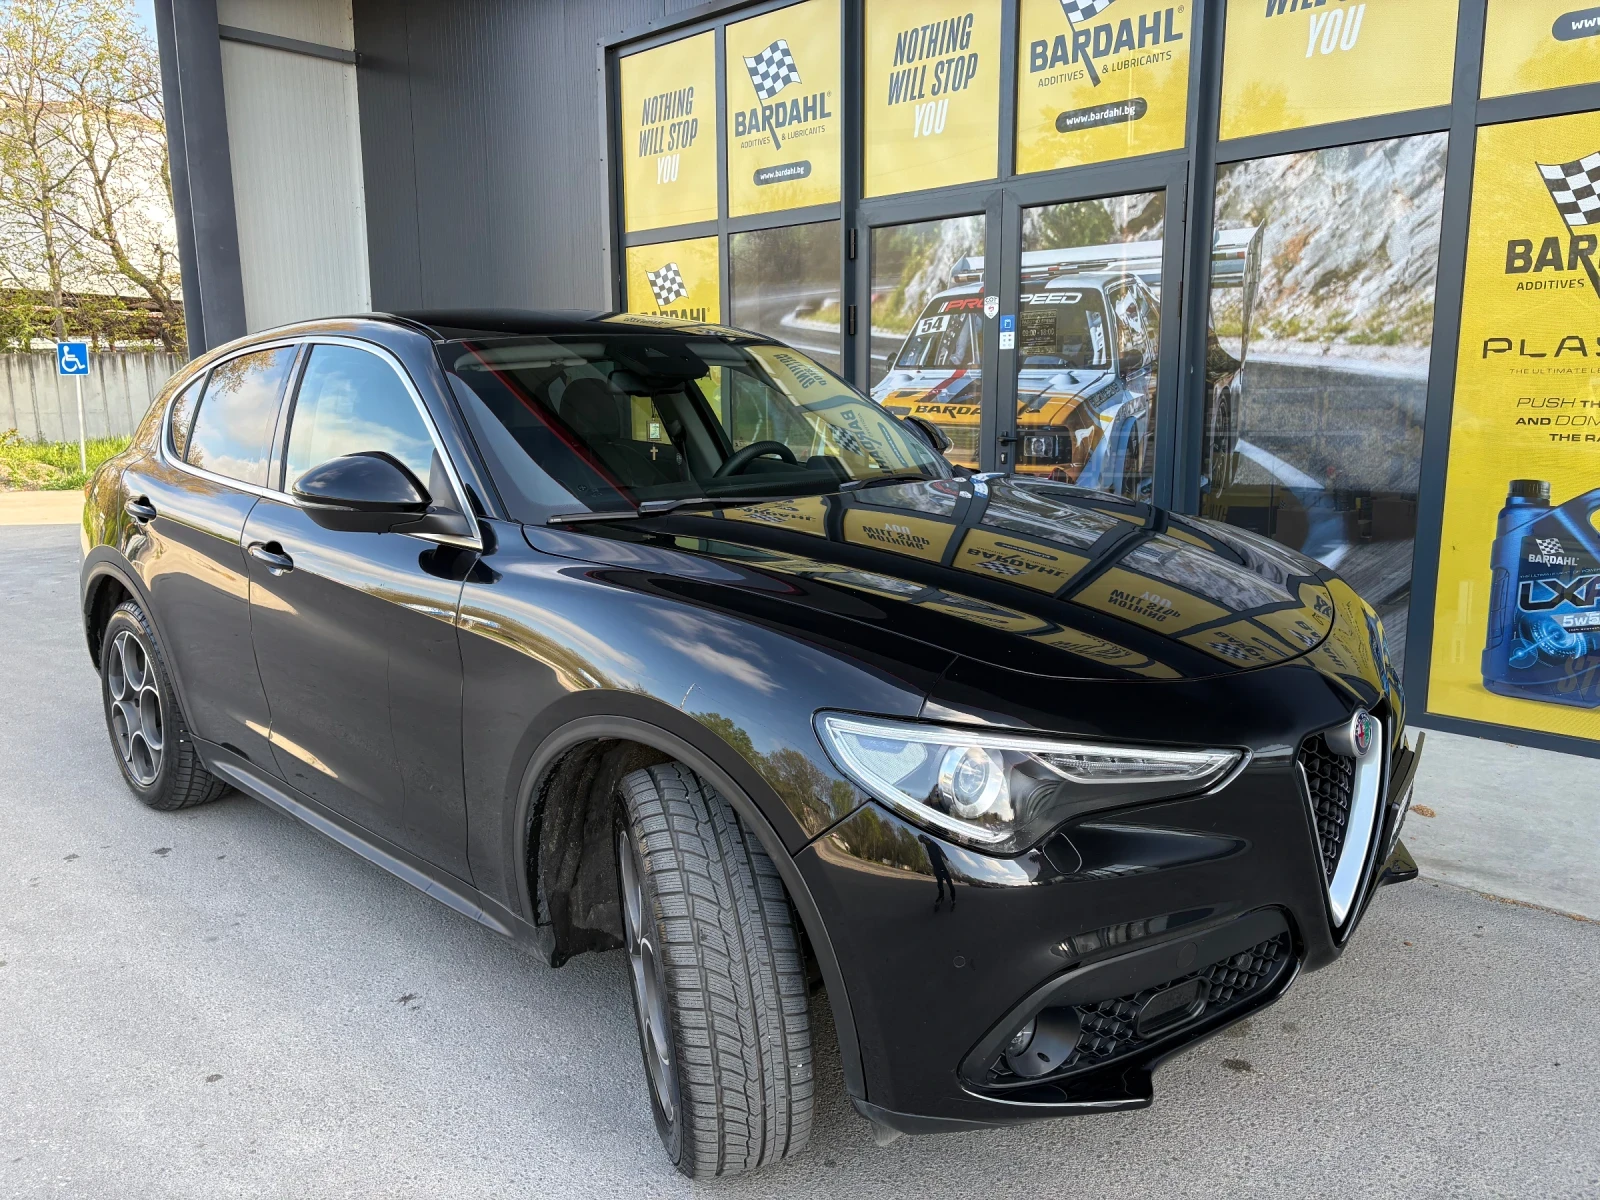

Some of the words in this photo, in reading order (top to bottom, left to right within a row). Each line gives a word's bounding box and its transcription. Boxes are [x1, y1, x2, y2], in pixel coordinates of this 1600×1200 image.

[893, 13, 974, 67] NOTHING
[1030, 7, 1183, 80] BARDAHL
[1306, 3, 1366, 58] YOU
[888, 66, 926, 106] WILL
[931, 52, 979, 97] STOP
[1038, 69, 1084, 88] ADDITIVES
[1101, 63, 1109, 74] &
[1111, 51, 1172, 73] LUBRICANTS
[641, 86, 694, 126] NOTHING
[735, 91, 832, 143] BARDAHL
[913, 98, 949, 138] YOU
[1066, 103, 1136, 126] www.bardahl.bg
[639, 124, 664, 157] WILL
[668, 118, 698, 151] STOP
[740, 136, 771, 150] ADDITIVES
[781, 133, 787, 141] &
[787, 125, 826, 140] LUBRICANTS
[656, 153, 680, 185] YOU
[760, 165, 804, 181] www.bardahl.bg
[1505, 234, 1600, 282] BAR
[1516, 278, 1585, 291] ADDITIVES
[921, 317, 943, 333] 54
[1482, 335, 1600, 359] PLA
[1532, 367, 1588, 375] ULTIMATE
[1516, 398, 1576, 408] PUSH
[1515, 417, 1551, 426] AND
[1549, 433, 1581, 442] THE
[1528, 554, 1578, 567] BARDAHL
